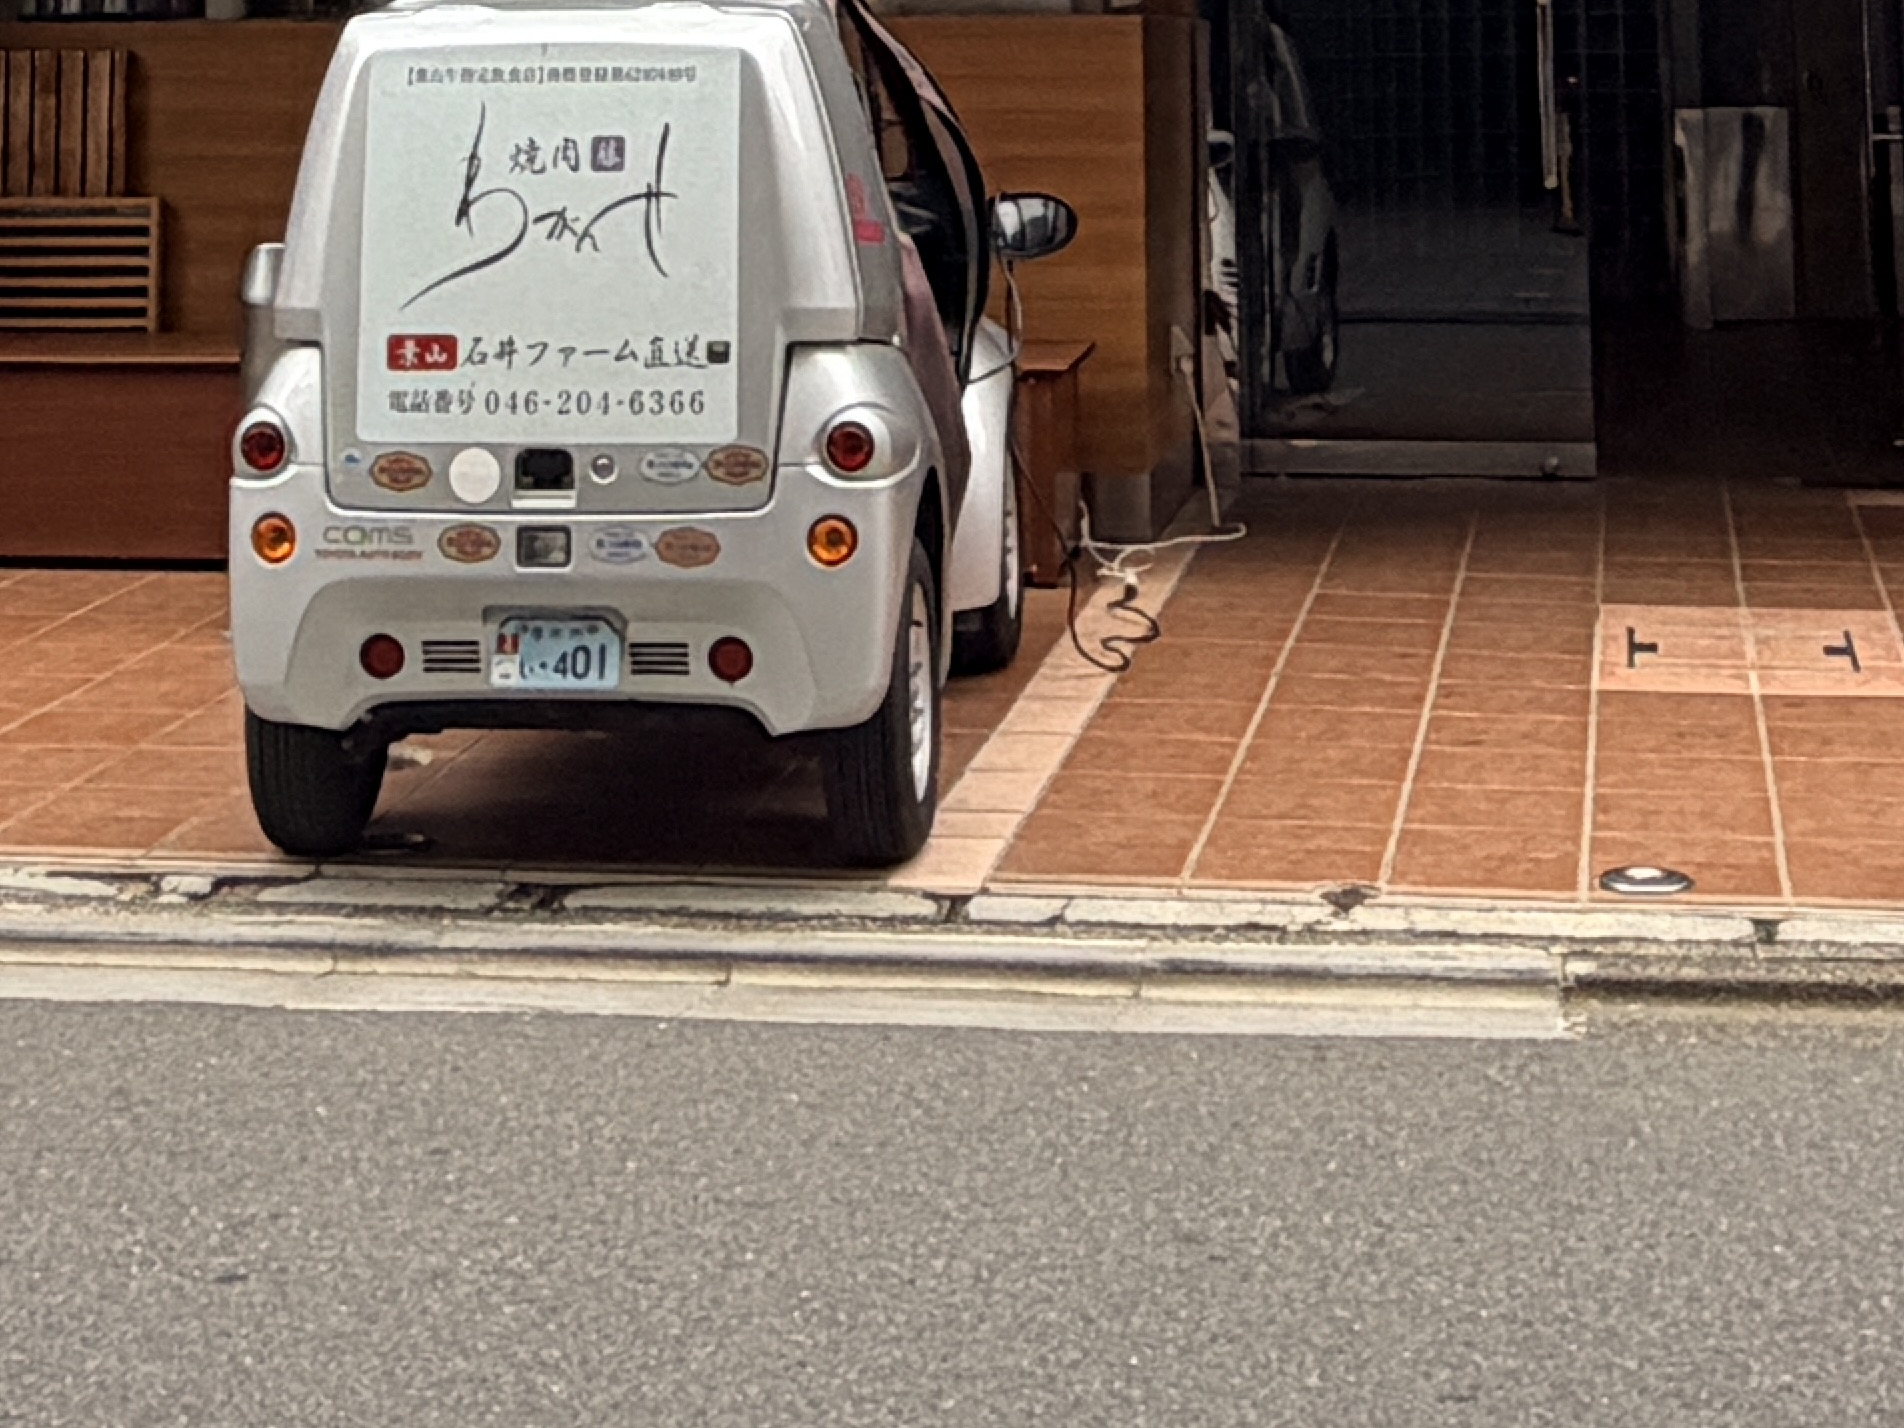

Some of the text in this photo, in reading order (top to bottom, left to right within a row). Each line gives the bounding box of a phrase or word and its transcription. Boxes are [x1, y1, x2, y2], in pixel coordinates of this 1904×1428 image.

[509, 136, 581, 174] 焼肉
[396, 338, 448, 368] 葉山
[460, 333, 710, 369] 石井ファーム直送
[484, 389, 706, 415] 046-204-6366
